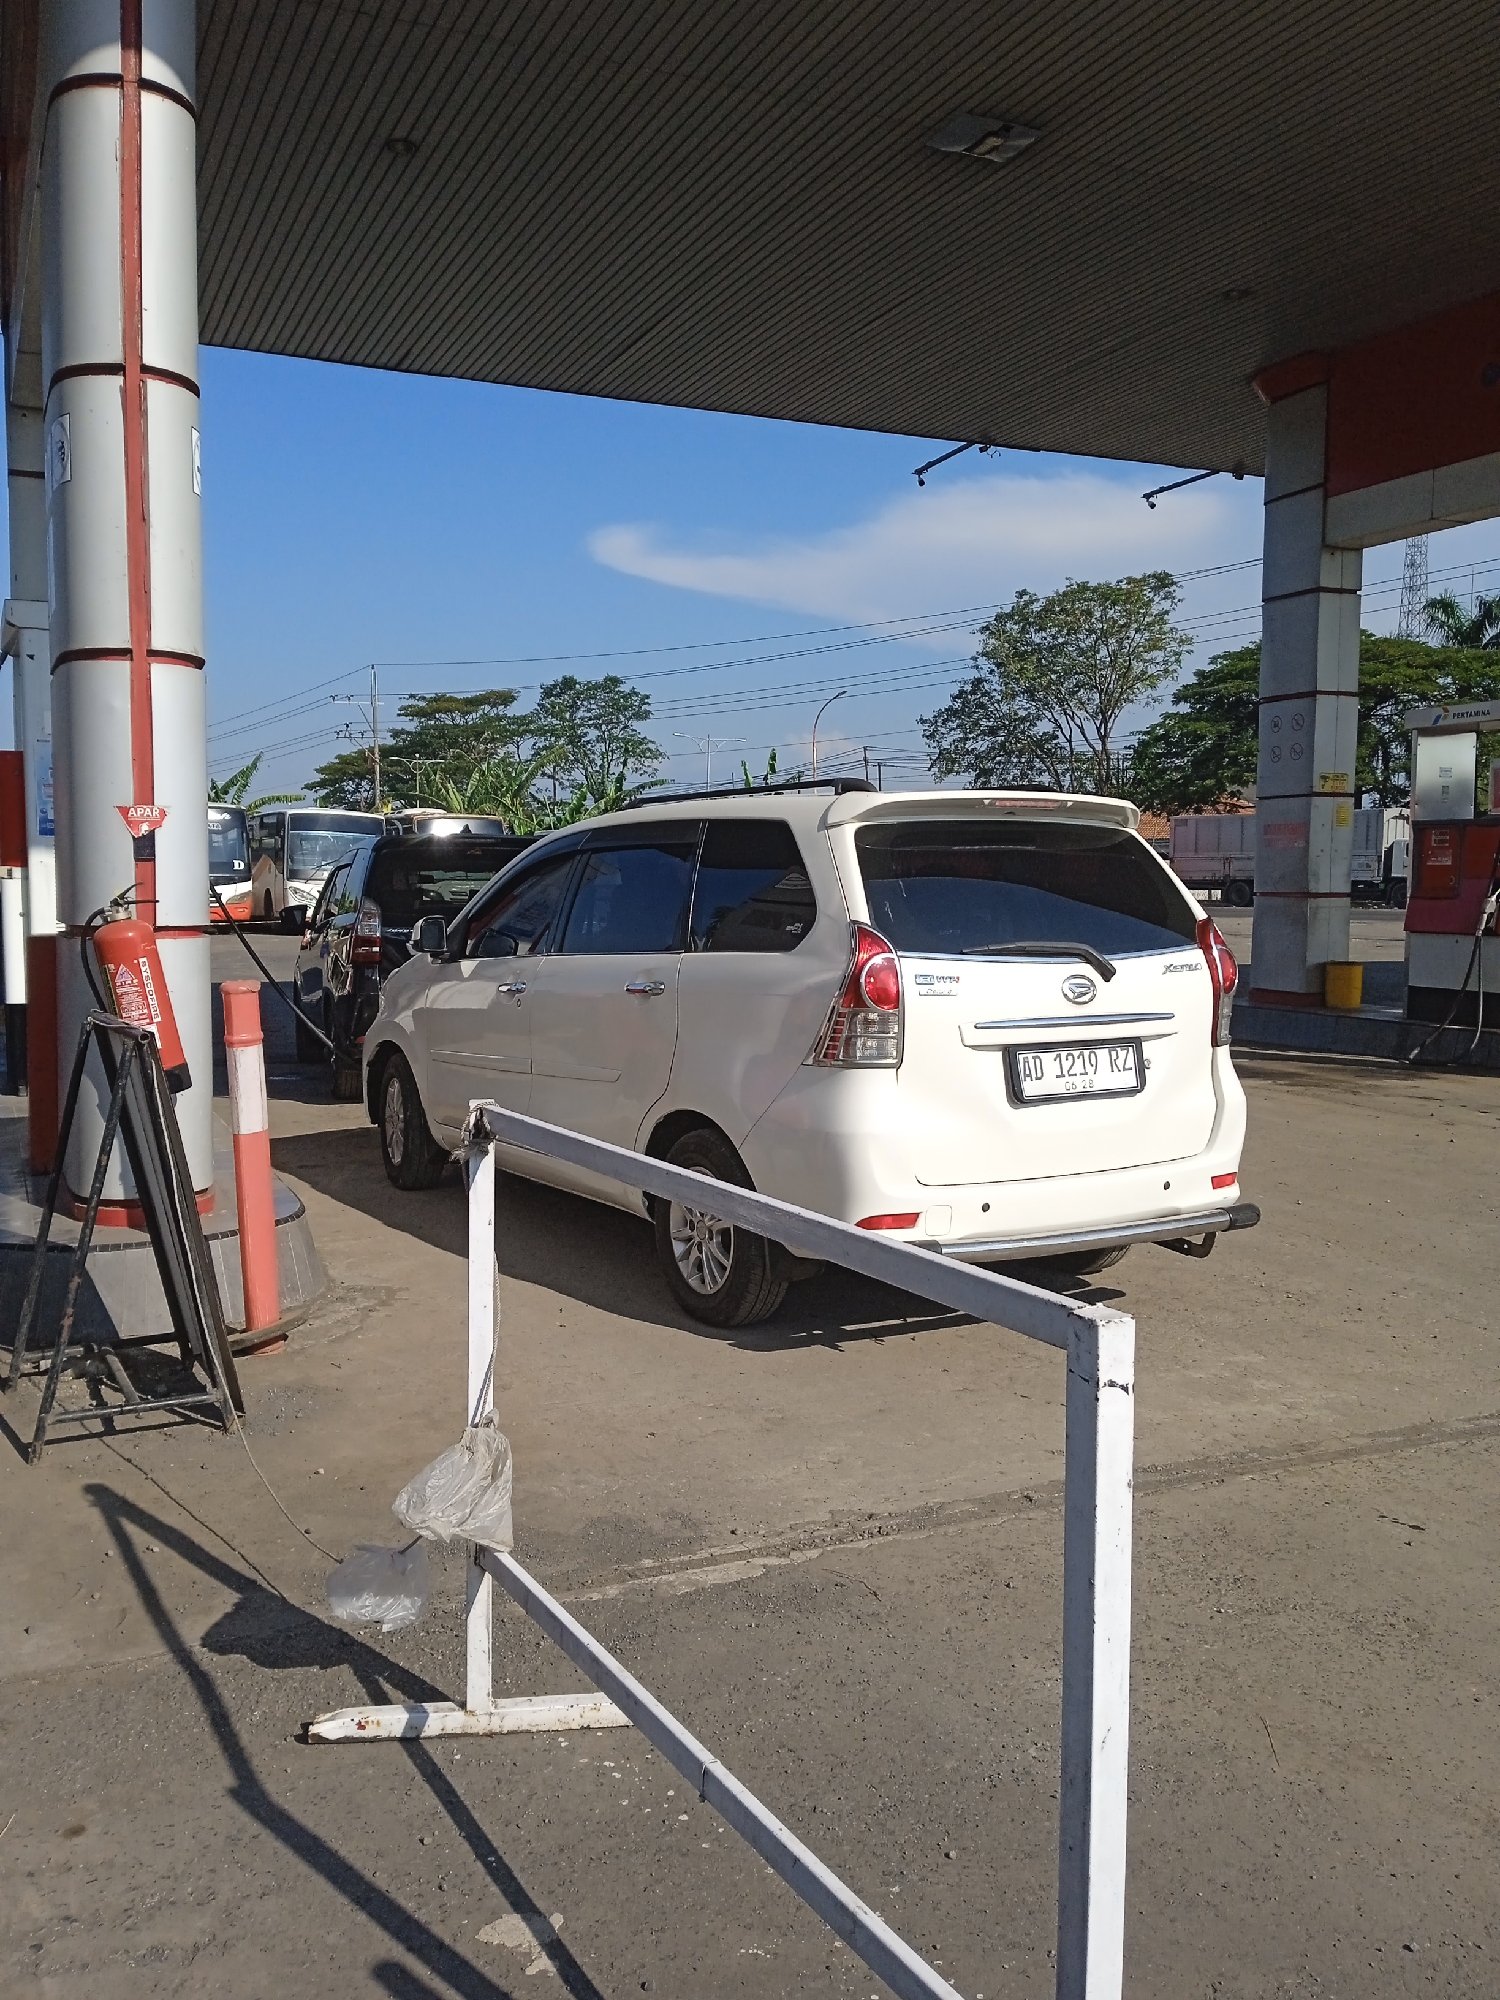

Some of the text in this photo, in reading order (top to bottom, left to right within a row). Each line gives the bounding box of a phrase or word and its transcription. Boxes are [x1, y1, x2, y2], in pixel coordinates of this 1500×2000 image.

[1453, 709, 1491, 719] PERTAMINA
[128, 806, 160, 817] APAR
[232, 860, 245, 870] D
[1022, 1047, 1133, 1081] AD 1219 RZ
[1082, 1079, 1094, 1089] 28
